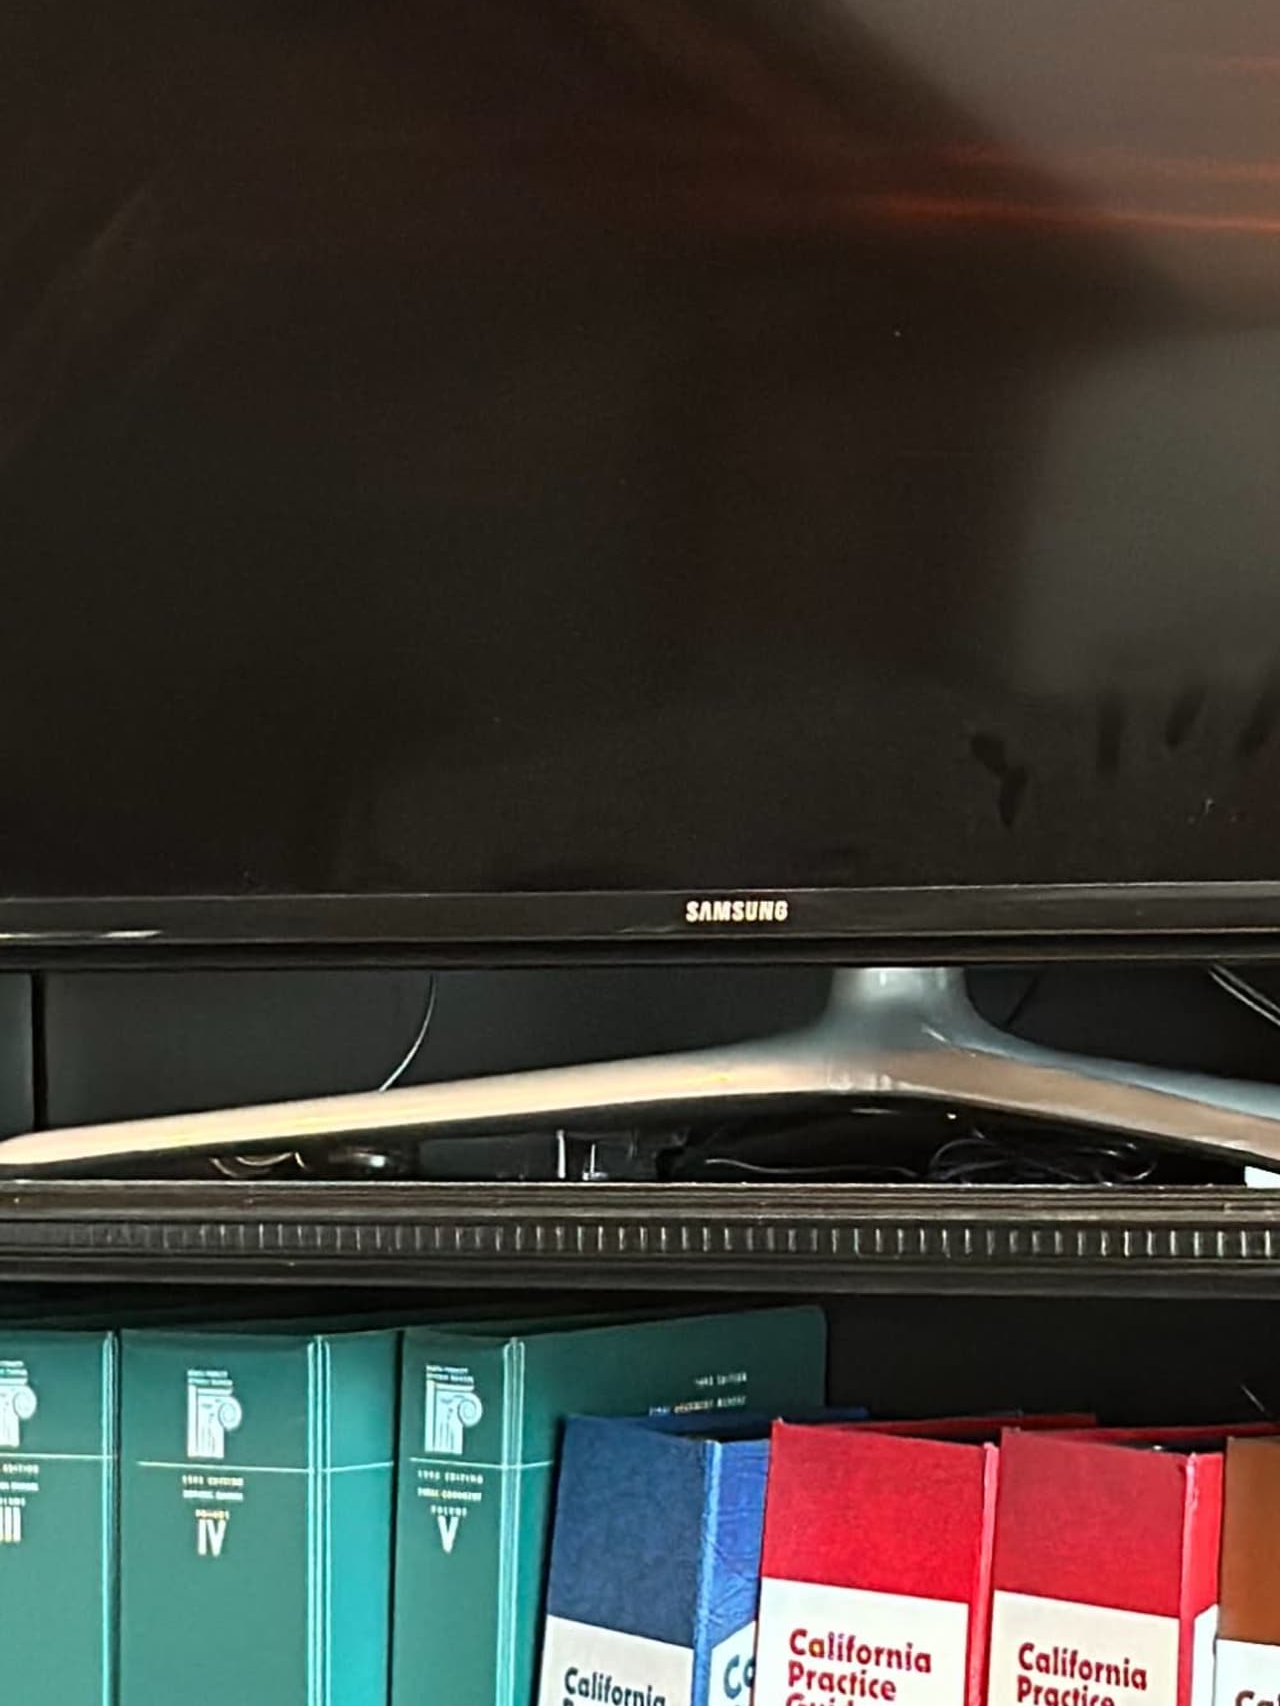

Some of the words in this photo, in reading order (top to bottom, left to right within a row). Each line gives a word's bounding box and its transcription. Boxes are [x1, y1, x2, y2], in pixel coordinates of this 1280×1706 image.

[686, 900, 788, 922] SAMSUNG
[198, 1519, 225, 1556] IV
[438, 1516, 458, 1553] V
[790, 1629, 931, 1673] California
[1018, 1643, 1148, 1690] California
[788, 1661, 897, 1702] Practice
